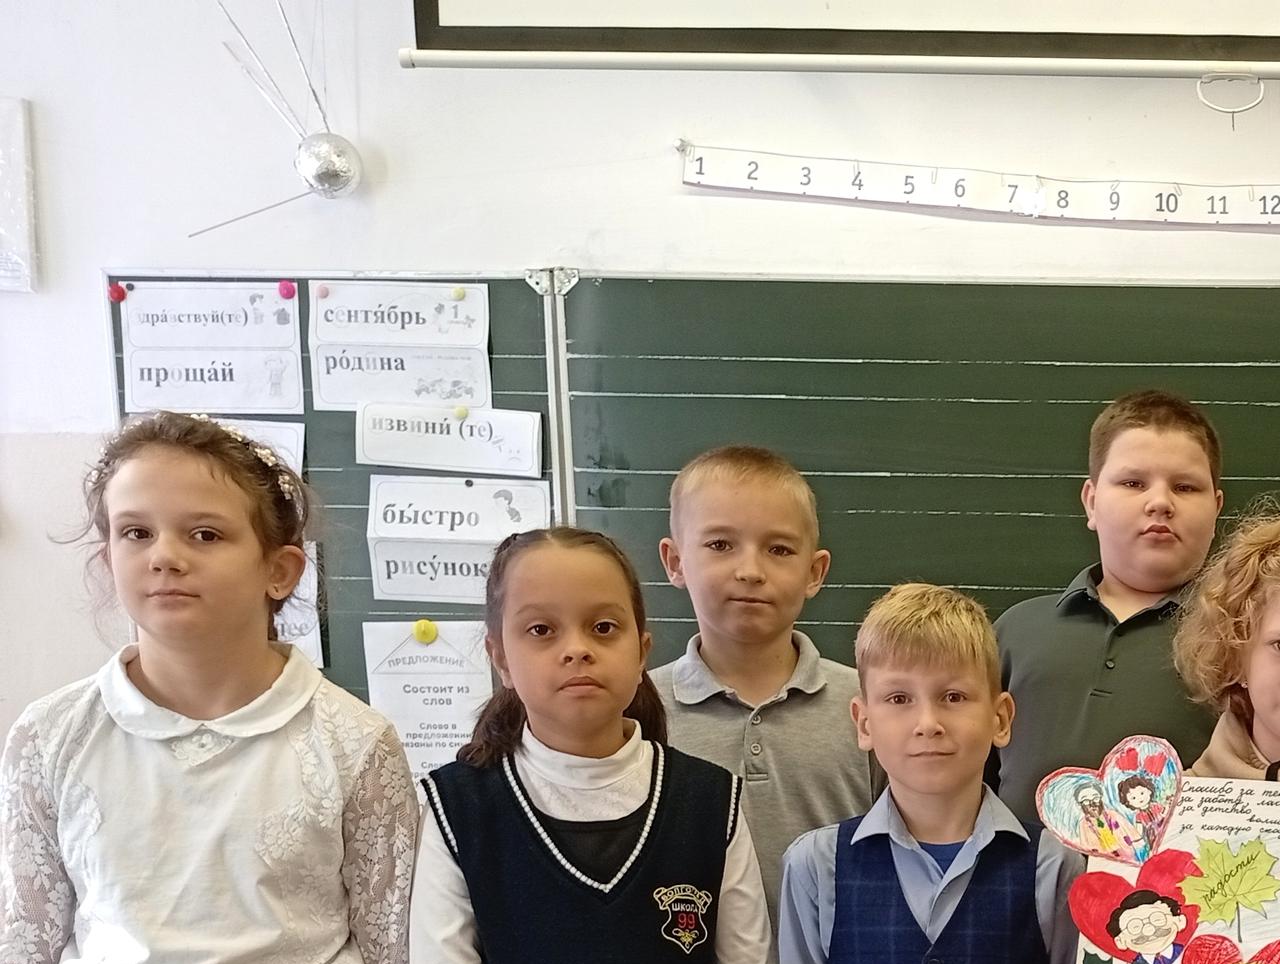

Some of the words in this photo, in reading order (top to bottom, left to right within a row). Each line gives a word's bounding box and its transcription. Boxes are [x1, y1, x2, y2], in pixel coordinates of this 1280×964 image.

[695, 157, 706, 176] 1
[746, 161, 760, 180] 2
[800, 167, 812, 185] 3
[851, 171, 864, 190] 4
[904, 176, 915, 195] 5
[954, 179, 966, 198] 6
[1007, 185, 1019, 203] 7
[1057, 190, 1069, 209] 8
[1109, 192, 1120, 211] 9
[1155, 192, 1178, 213] 10
[1207, 196, 1229, 215] 11
[1259, 196, 1280, 215] 12
[388, 655, 465, 668] ПРЕДЛОЖЕНИЕ
[403, 684, 453, 694] Состоит
[422, 698, 452, 706] слов
[1181, 781, 1233, 794] Спасибо
[1239, 788, 1255, 800] за
[1178, 795, 1194, 806] за
[1179, 805, 1194, 816] за
[1180, 823, 1194, 833] за
[1200, 823, 1251, 835] каждую
[1202, 850, 1261, 909] радости
[678, 913, 695, 929] 99
